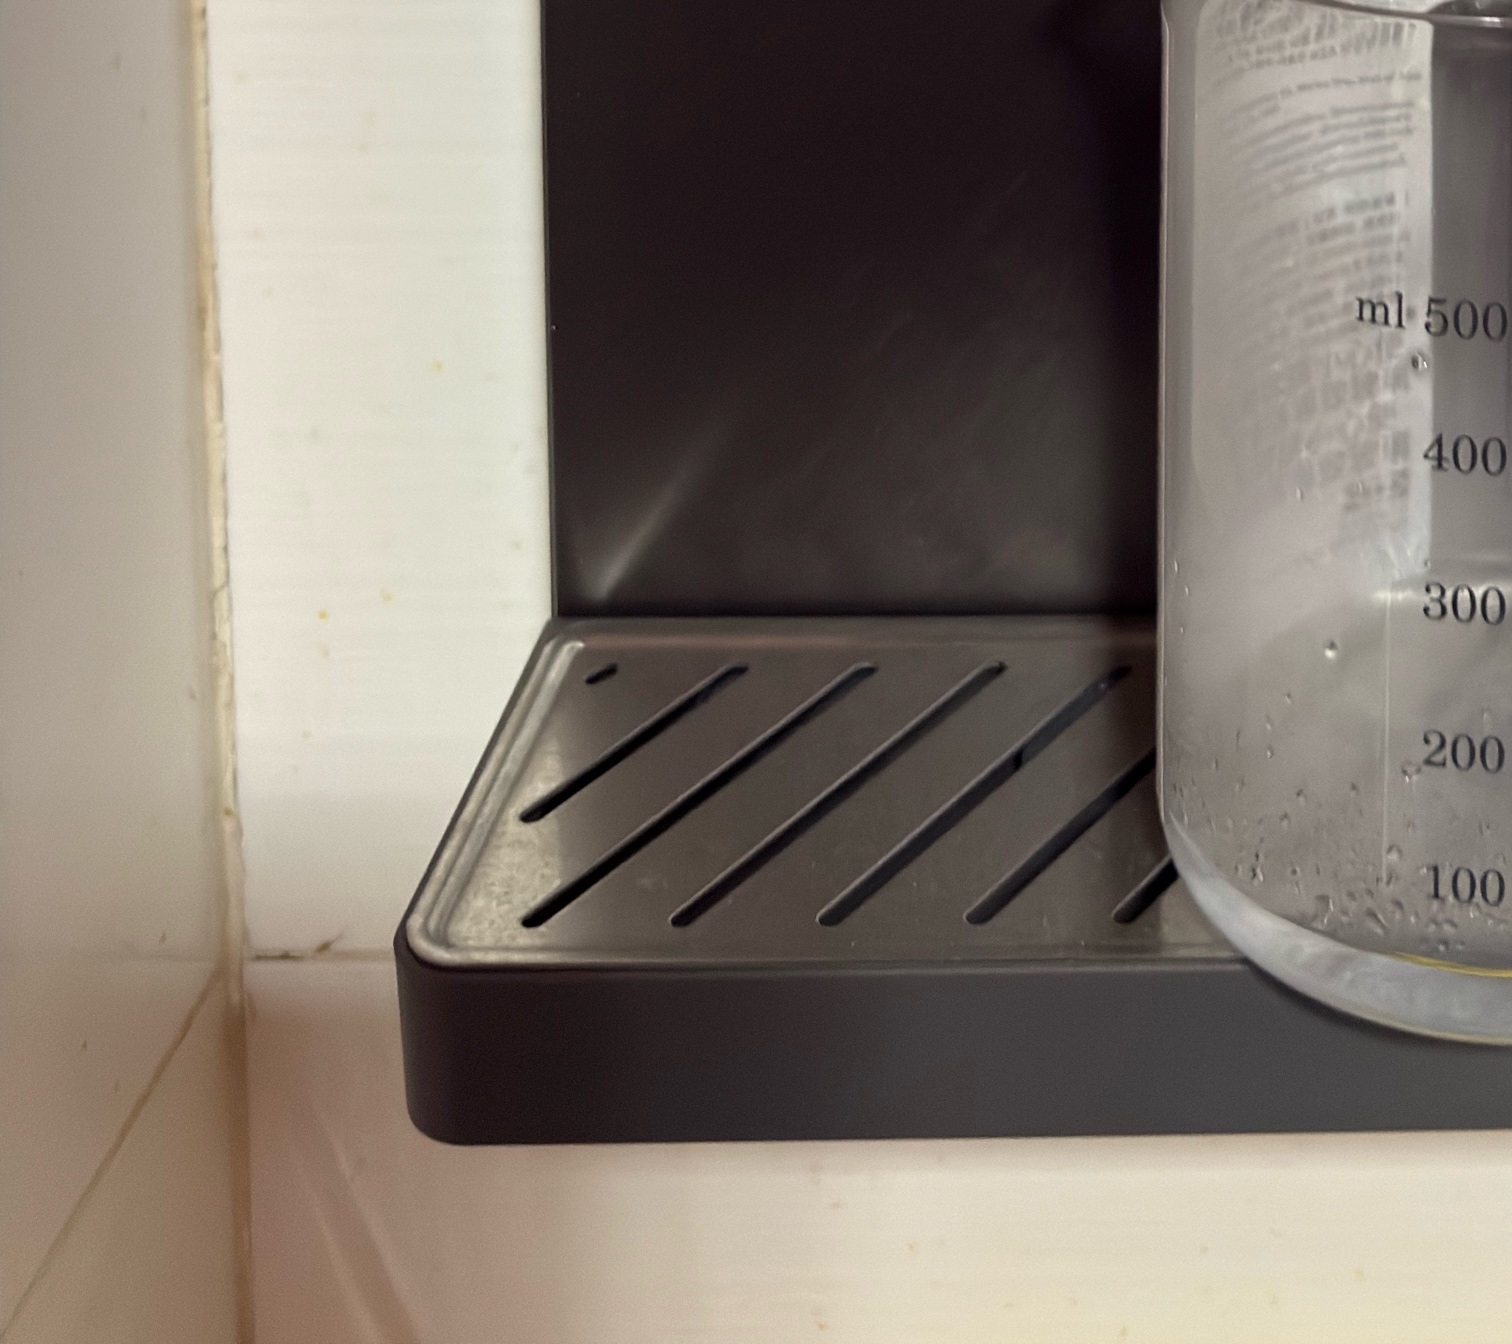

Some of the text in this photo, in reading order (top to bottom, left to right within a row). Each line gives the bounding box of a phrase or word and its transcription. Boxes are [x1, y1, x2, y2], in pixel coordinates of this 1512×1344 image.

[1355, 290, 1406, 330] ml
[1424, 297, 1508, 343] 500
[1422, 432, 1508, 477] 400
[1422, 581, 1507, 627] 300
[1421, 729, 1506, 774] 200
[1427, 864, 1506, 907] 100
